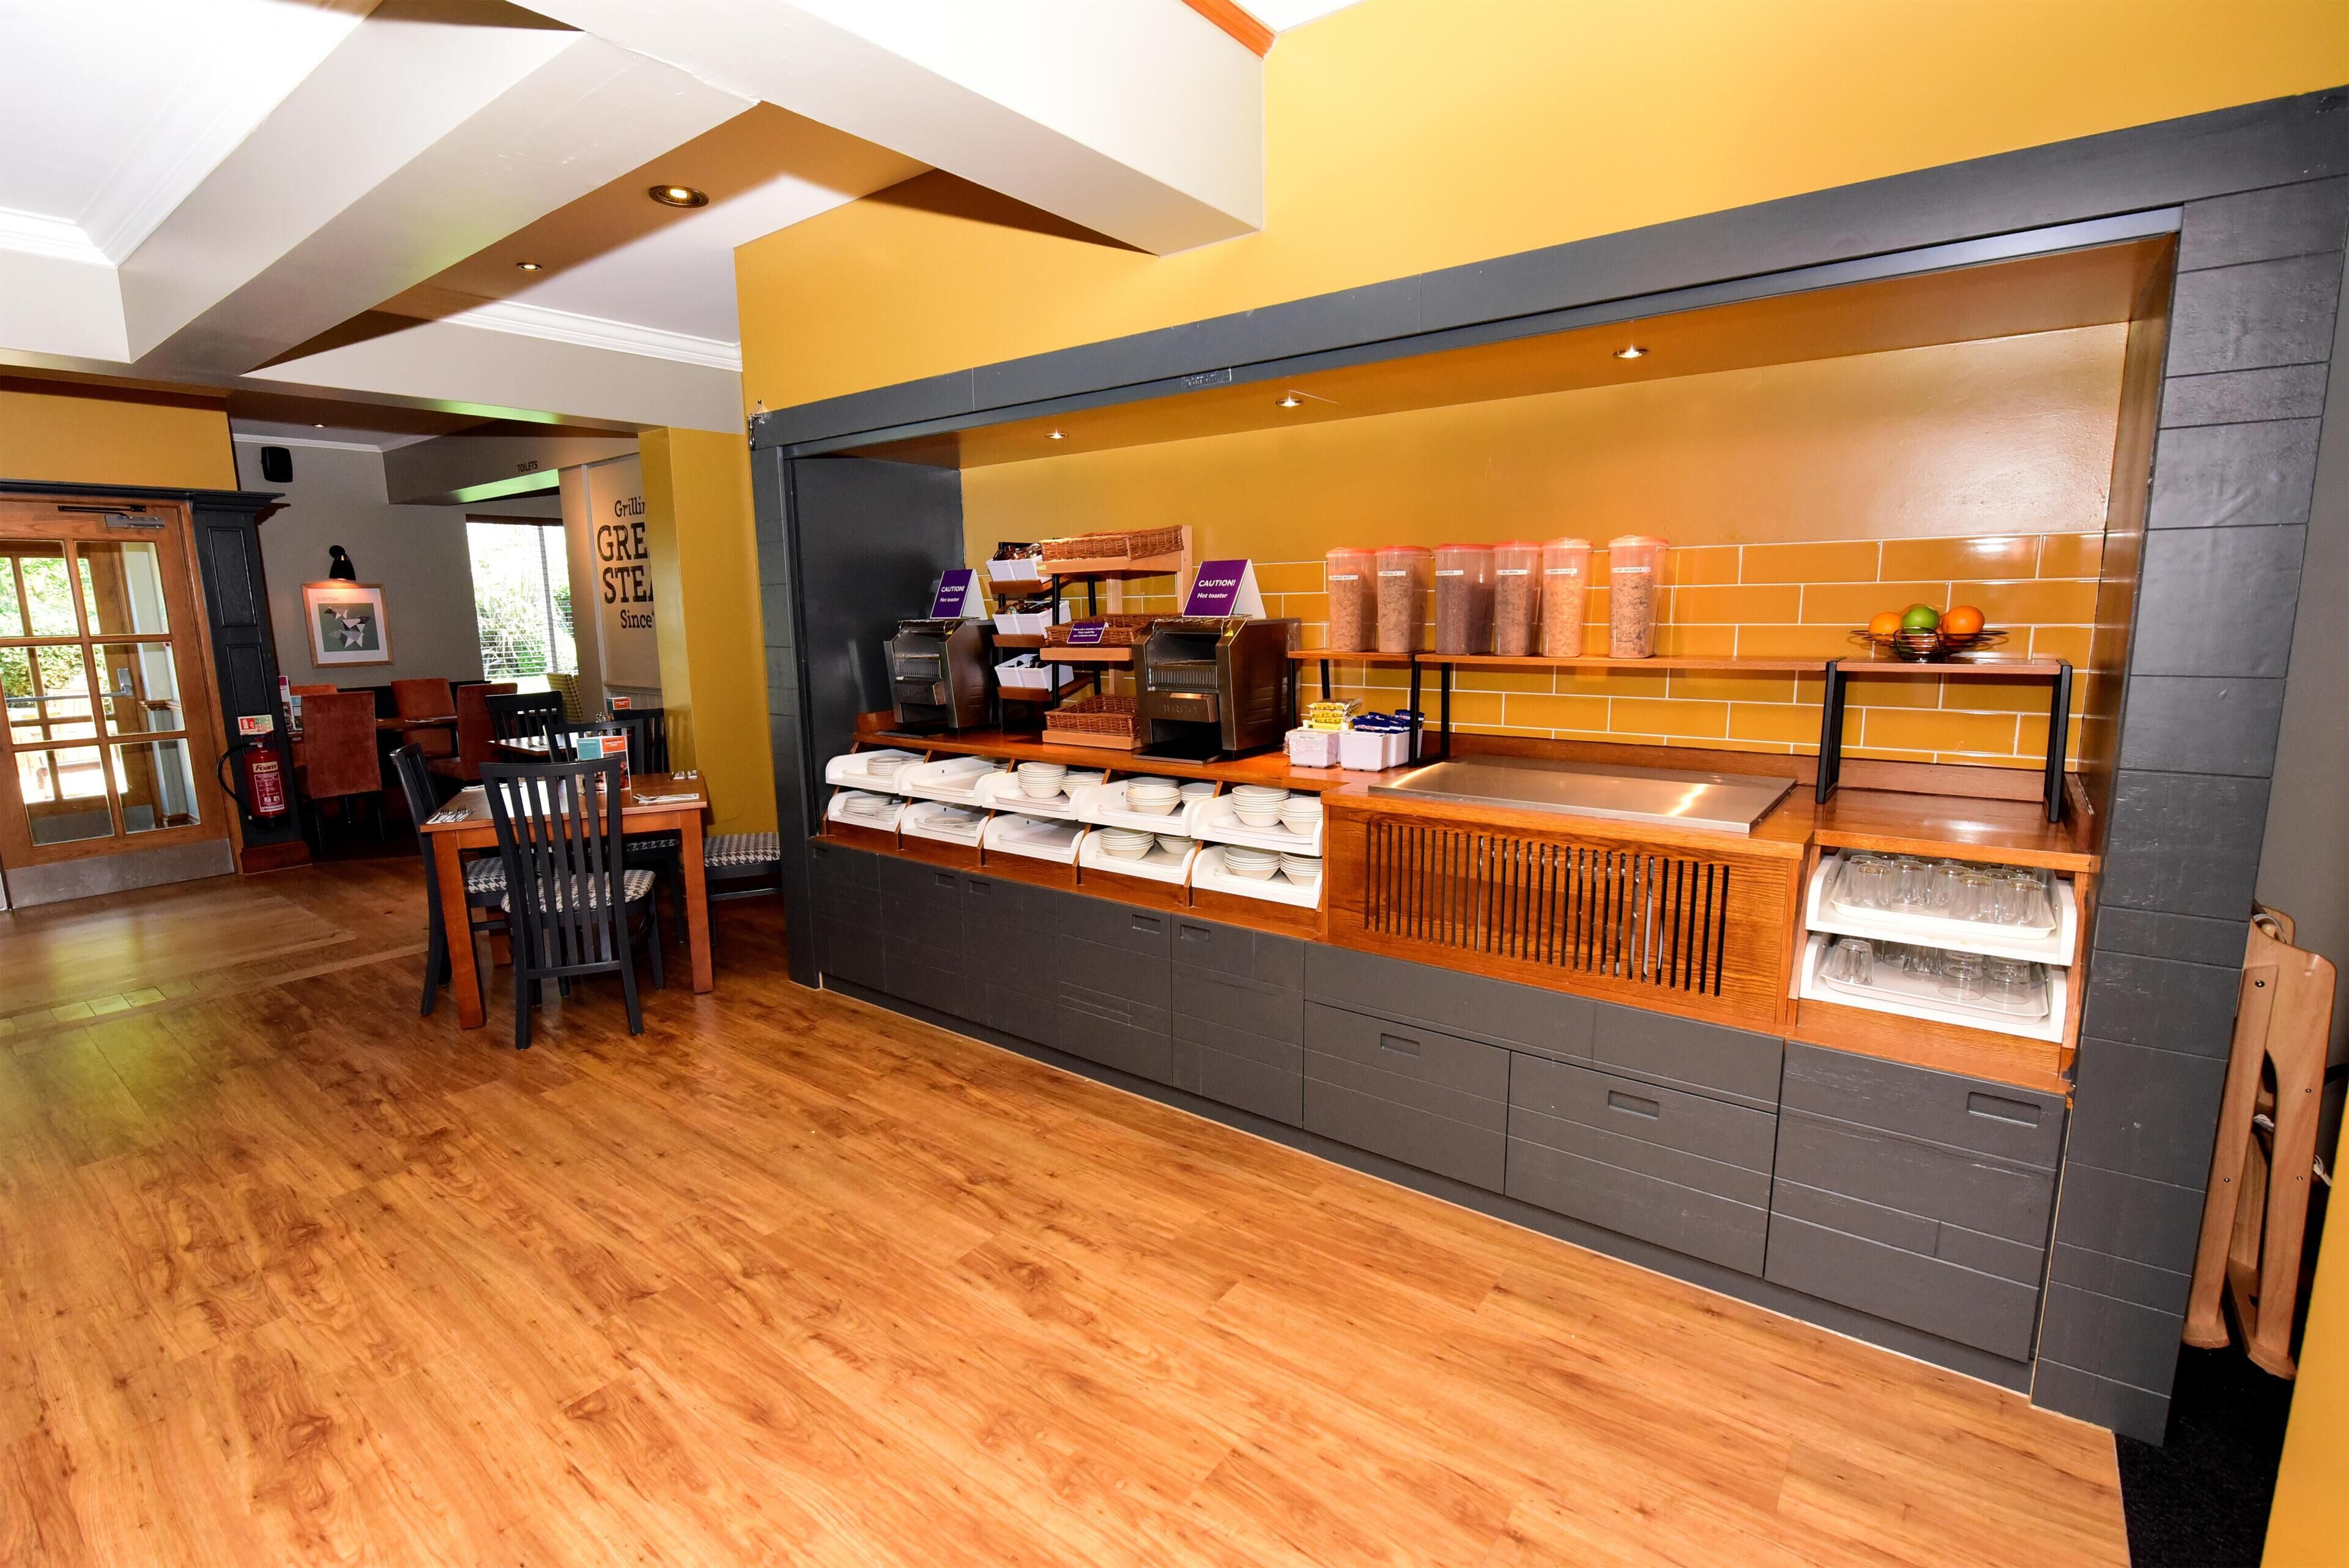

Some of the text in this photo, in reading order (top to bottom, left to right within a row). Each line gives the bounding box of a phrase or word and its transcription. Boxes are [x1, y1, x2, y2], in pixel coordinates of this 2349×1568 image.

[518, 460, 538, 472] TOILETS
[597, 522, 650, 562] GRE
[1198, 579, 1236, 587] CAUTION!
